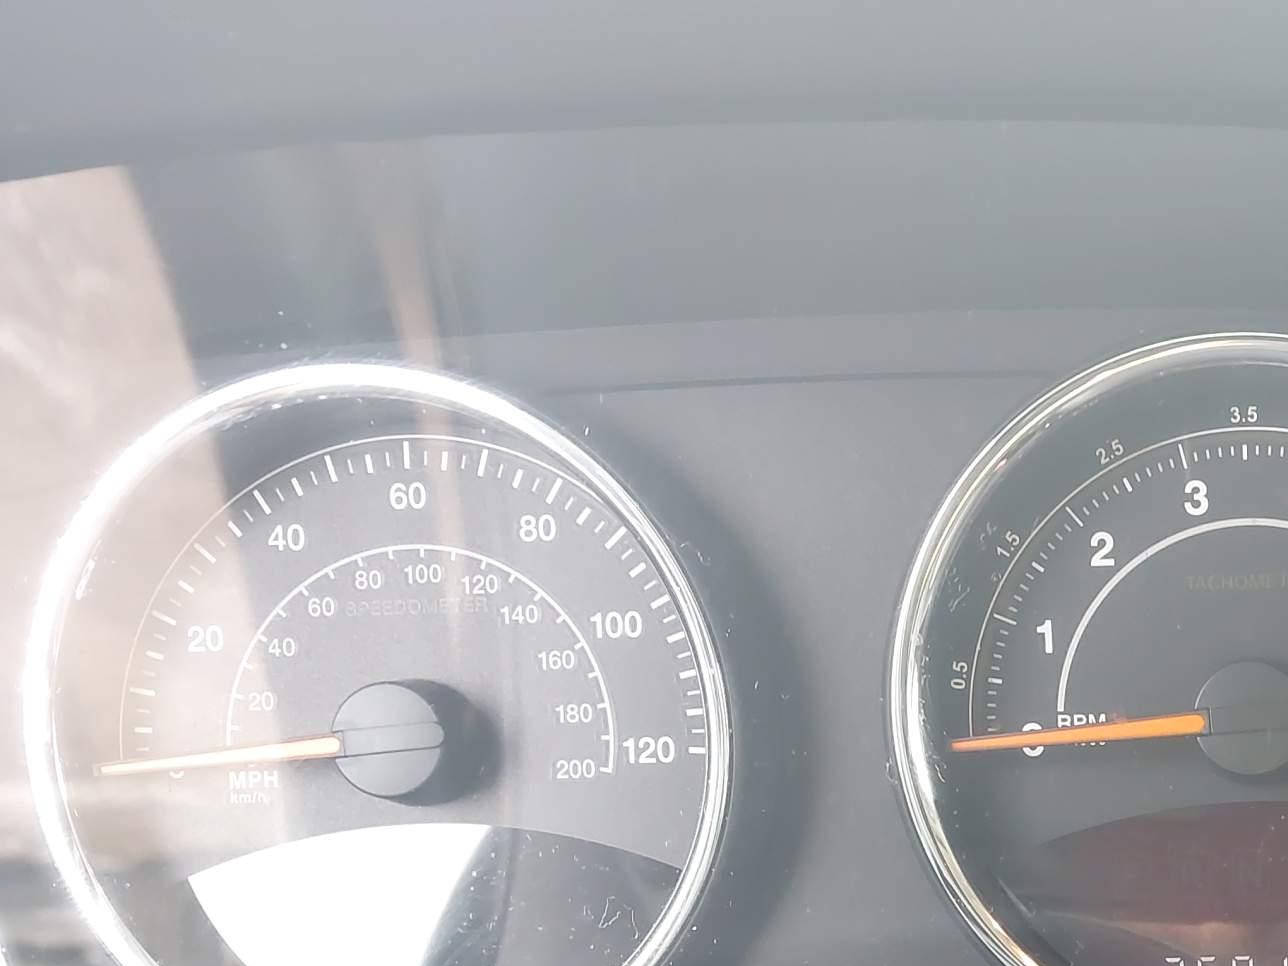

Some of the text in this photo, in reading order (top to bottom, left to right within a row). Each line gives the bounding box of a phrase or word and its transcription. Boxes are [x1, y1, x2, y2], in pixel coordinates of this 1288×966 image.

[1231, 407, 1257, 422] 3.5
[1096, 441, 1124, 461] 2.5
[390, 482, 426, 509] 60
[1185, 480, 1208, 514] 3
[268, 524, 304, 551] 40
[520, 515, 556, 541] 80
[998, 531, 1020, 558] 1.5
[1091, 532, 1114, 566] 2
[356, 570, 381, 589] 80
[405, 564, 444, 584] 100
[461, 575, 498, 594] 120
[306, 595, 334, 616] 60
[501, 605, 541, 624] 140
[590, 611, 642, 638] 100
[188, 625, 223, 652] 20
[1037, 620, 1052, 653] 1
[266, 638, 295, 656] 40
[538, 650, 574, 670] 160
[951, 662, 967, 688] 0.5
[249, 692, 273, 710] 20
[556, 704, 592, 723] 180
[623, 737, 674, 763] 120
[557, 759, 595, 778] 200
[228, 770, 281, 789] MPH
